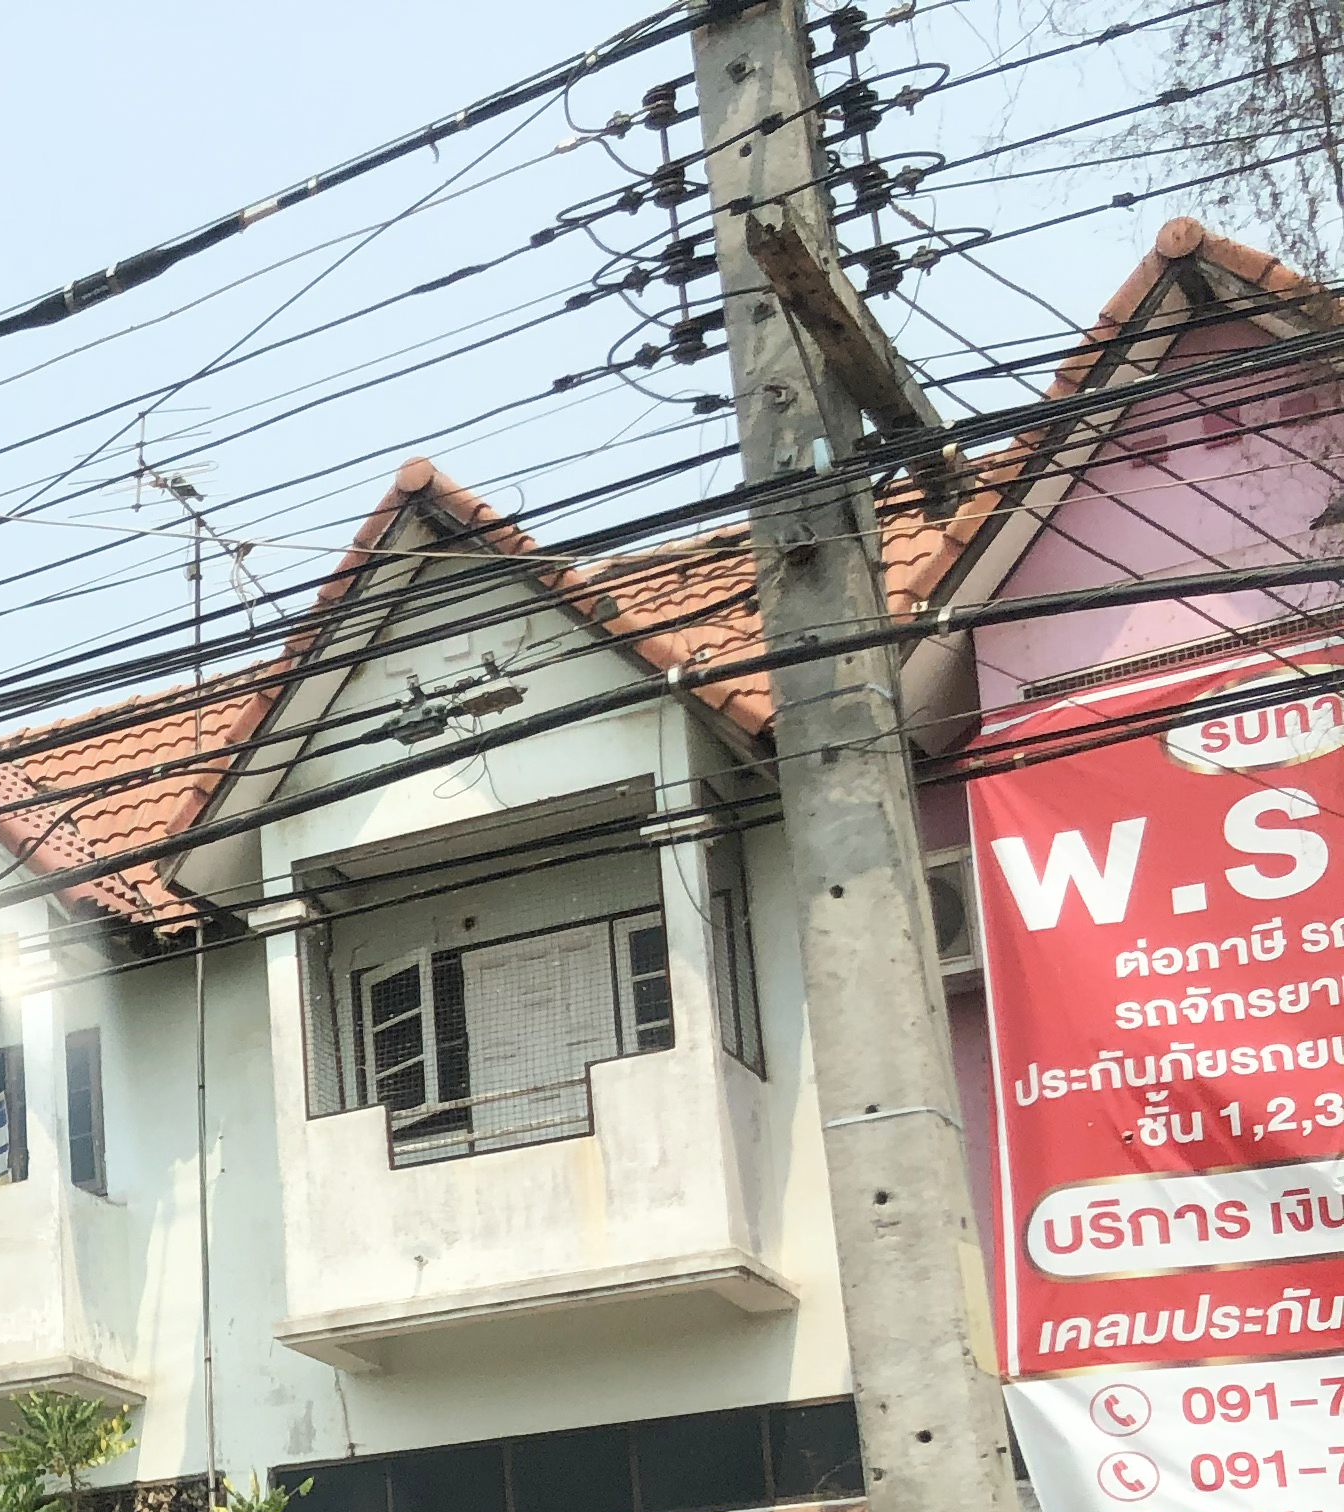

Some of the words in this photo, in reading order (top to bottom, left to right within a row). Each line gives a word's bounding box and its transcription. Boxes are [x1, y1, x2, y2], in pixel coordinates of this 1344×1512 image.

[1115, 917, 1287, 978] ต่อภาษี
[1115, 977, 1344, 1029] รถจักรยา
[1137, 1089, 1204, 1146] ชั้น
[1044, 1199, 1251, 1254] บริการ
[1038, 1288, 1344, 1354] เคลมประกัน
